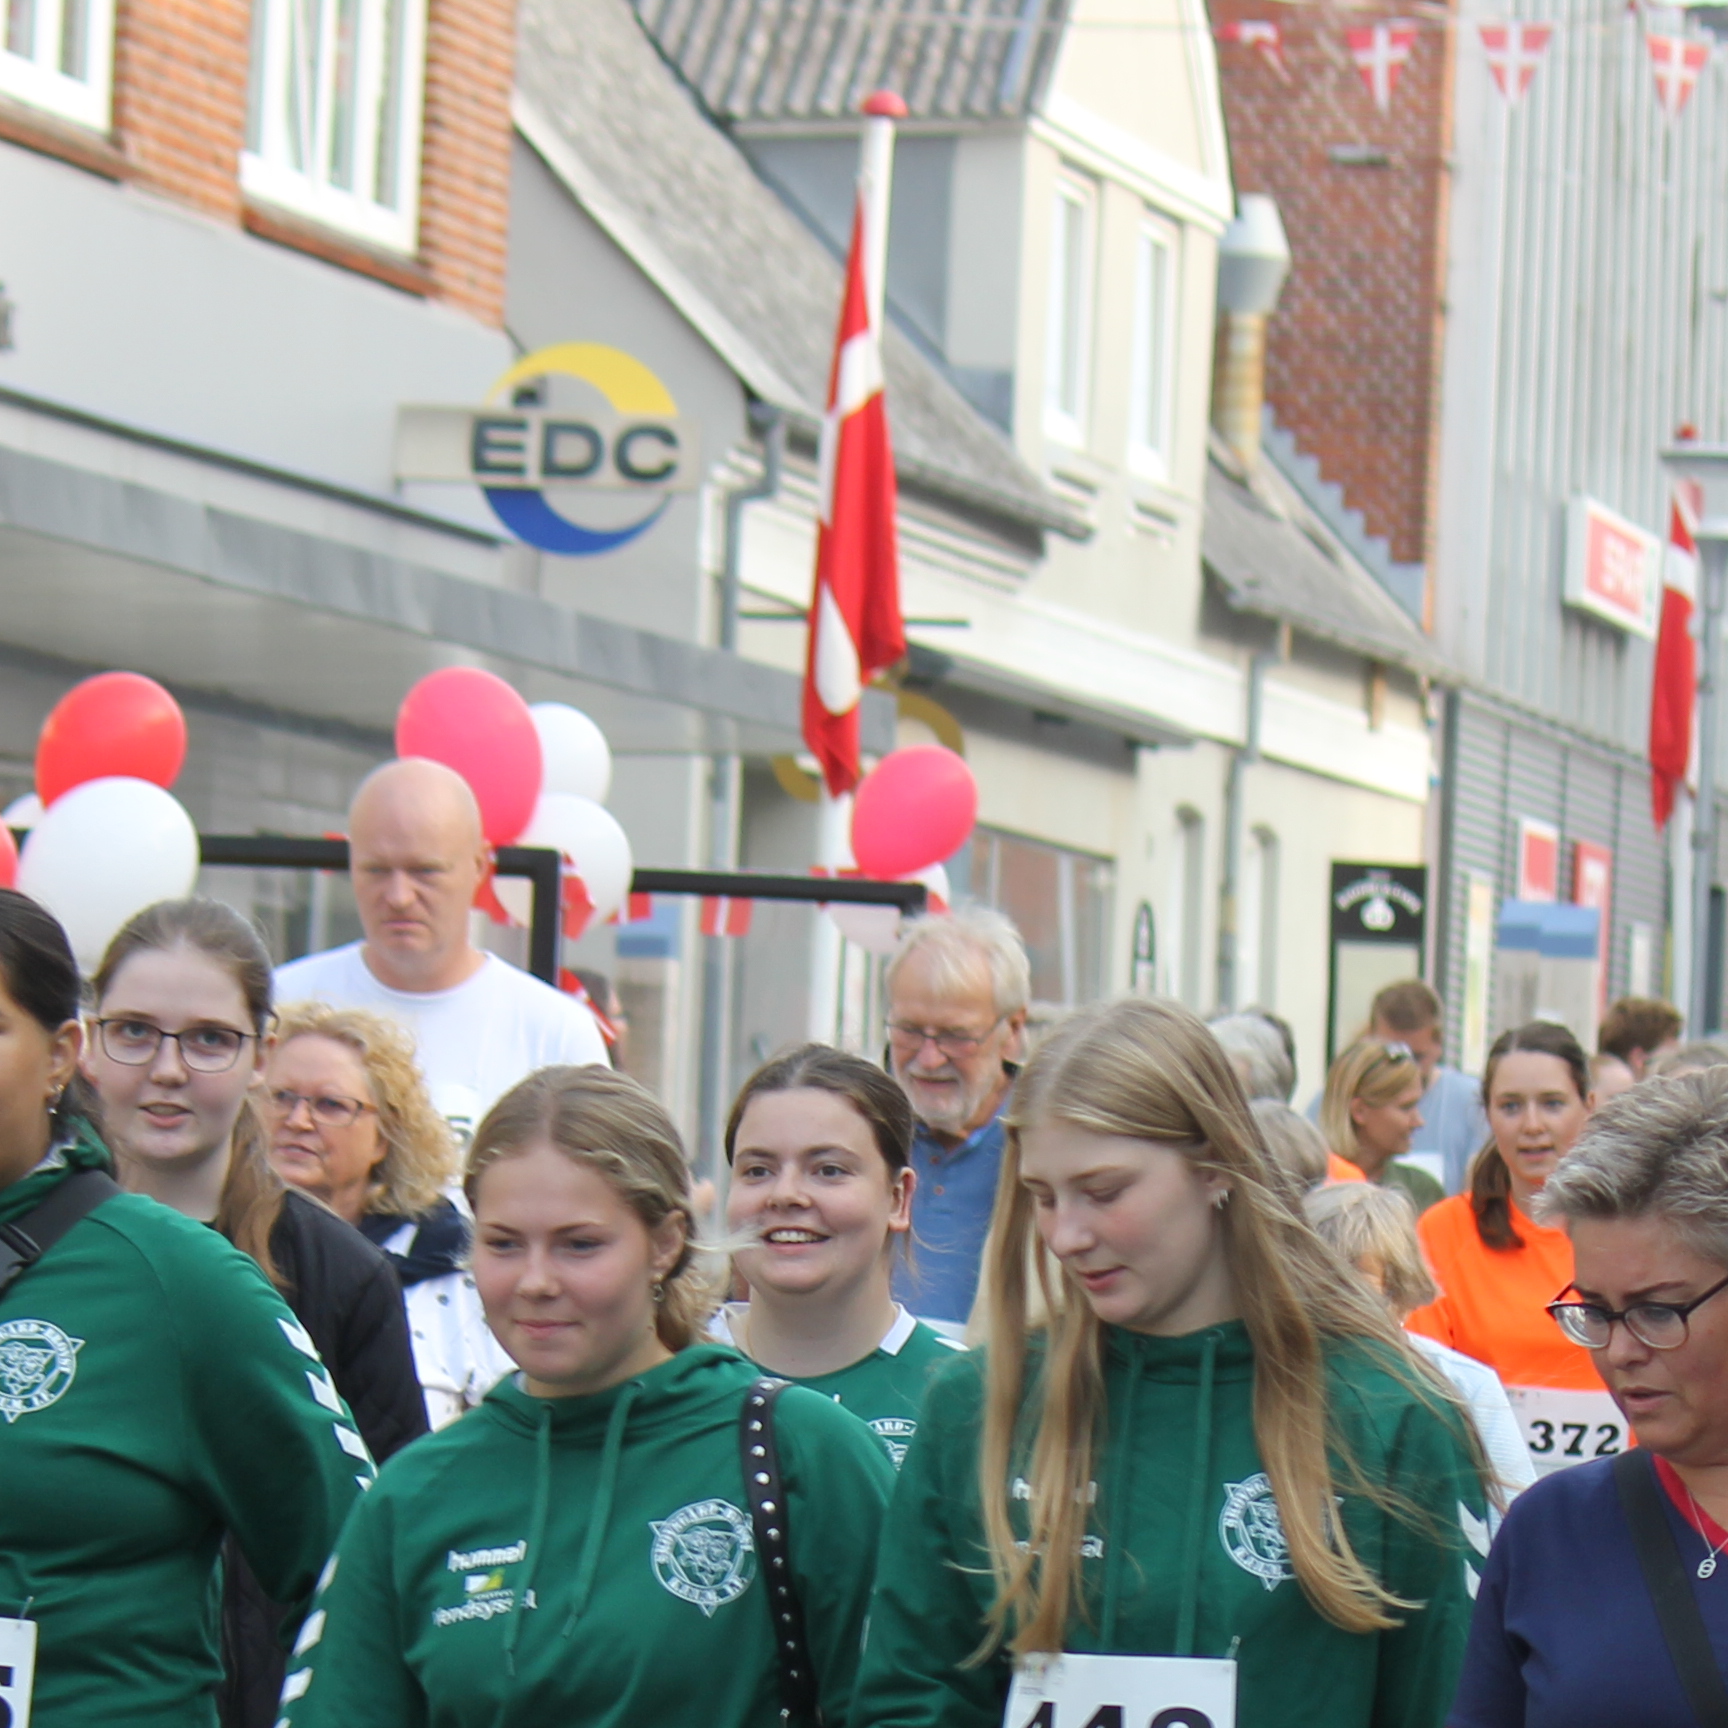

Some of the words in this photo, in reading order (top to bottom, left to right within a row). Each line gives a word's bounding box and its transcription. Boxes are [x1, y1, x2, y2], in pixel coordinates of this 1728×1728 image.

[470, 417, 680, 482] EDC
[1528, 1420, 1621, 1457] 372
[448, 1539, 528, 1572] hummel
